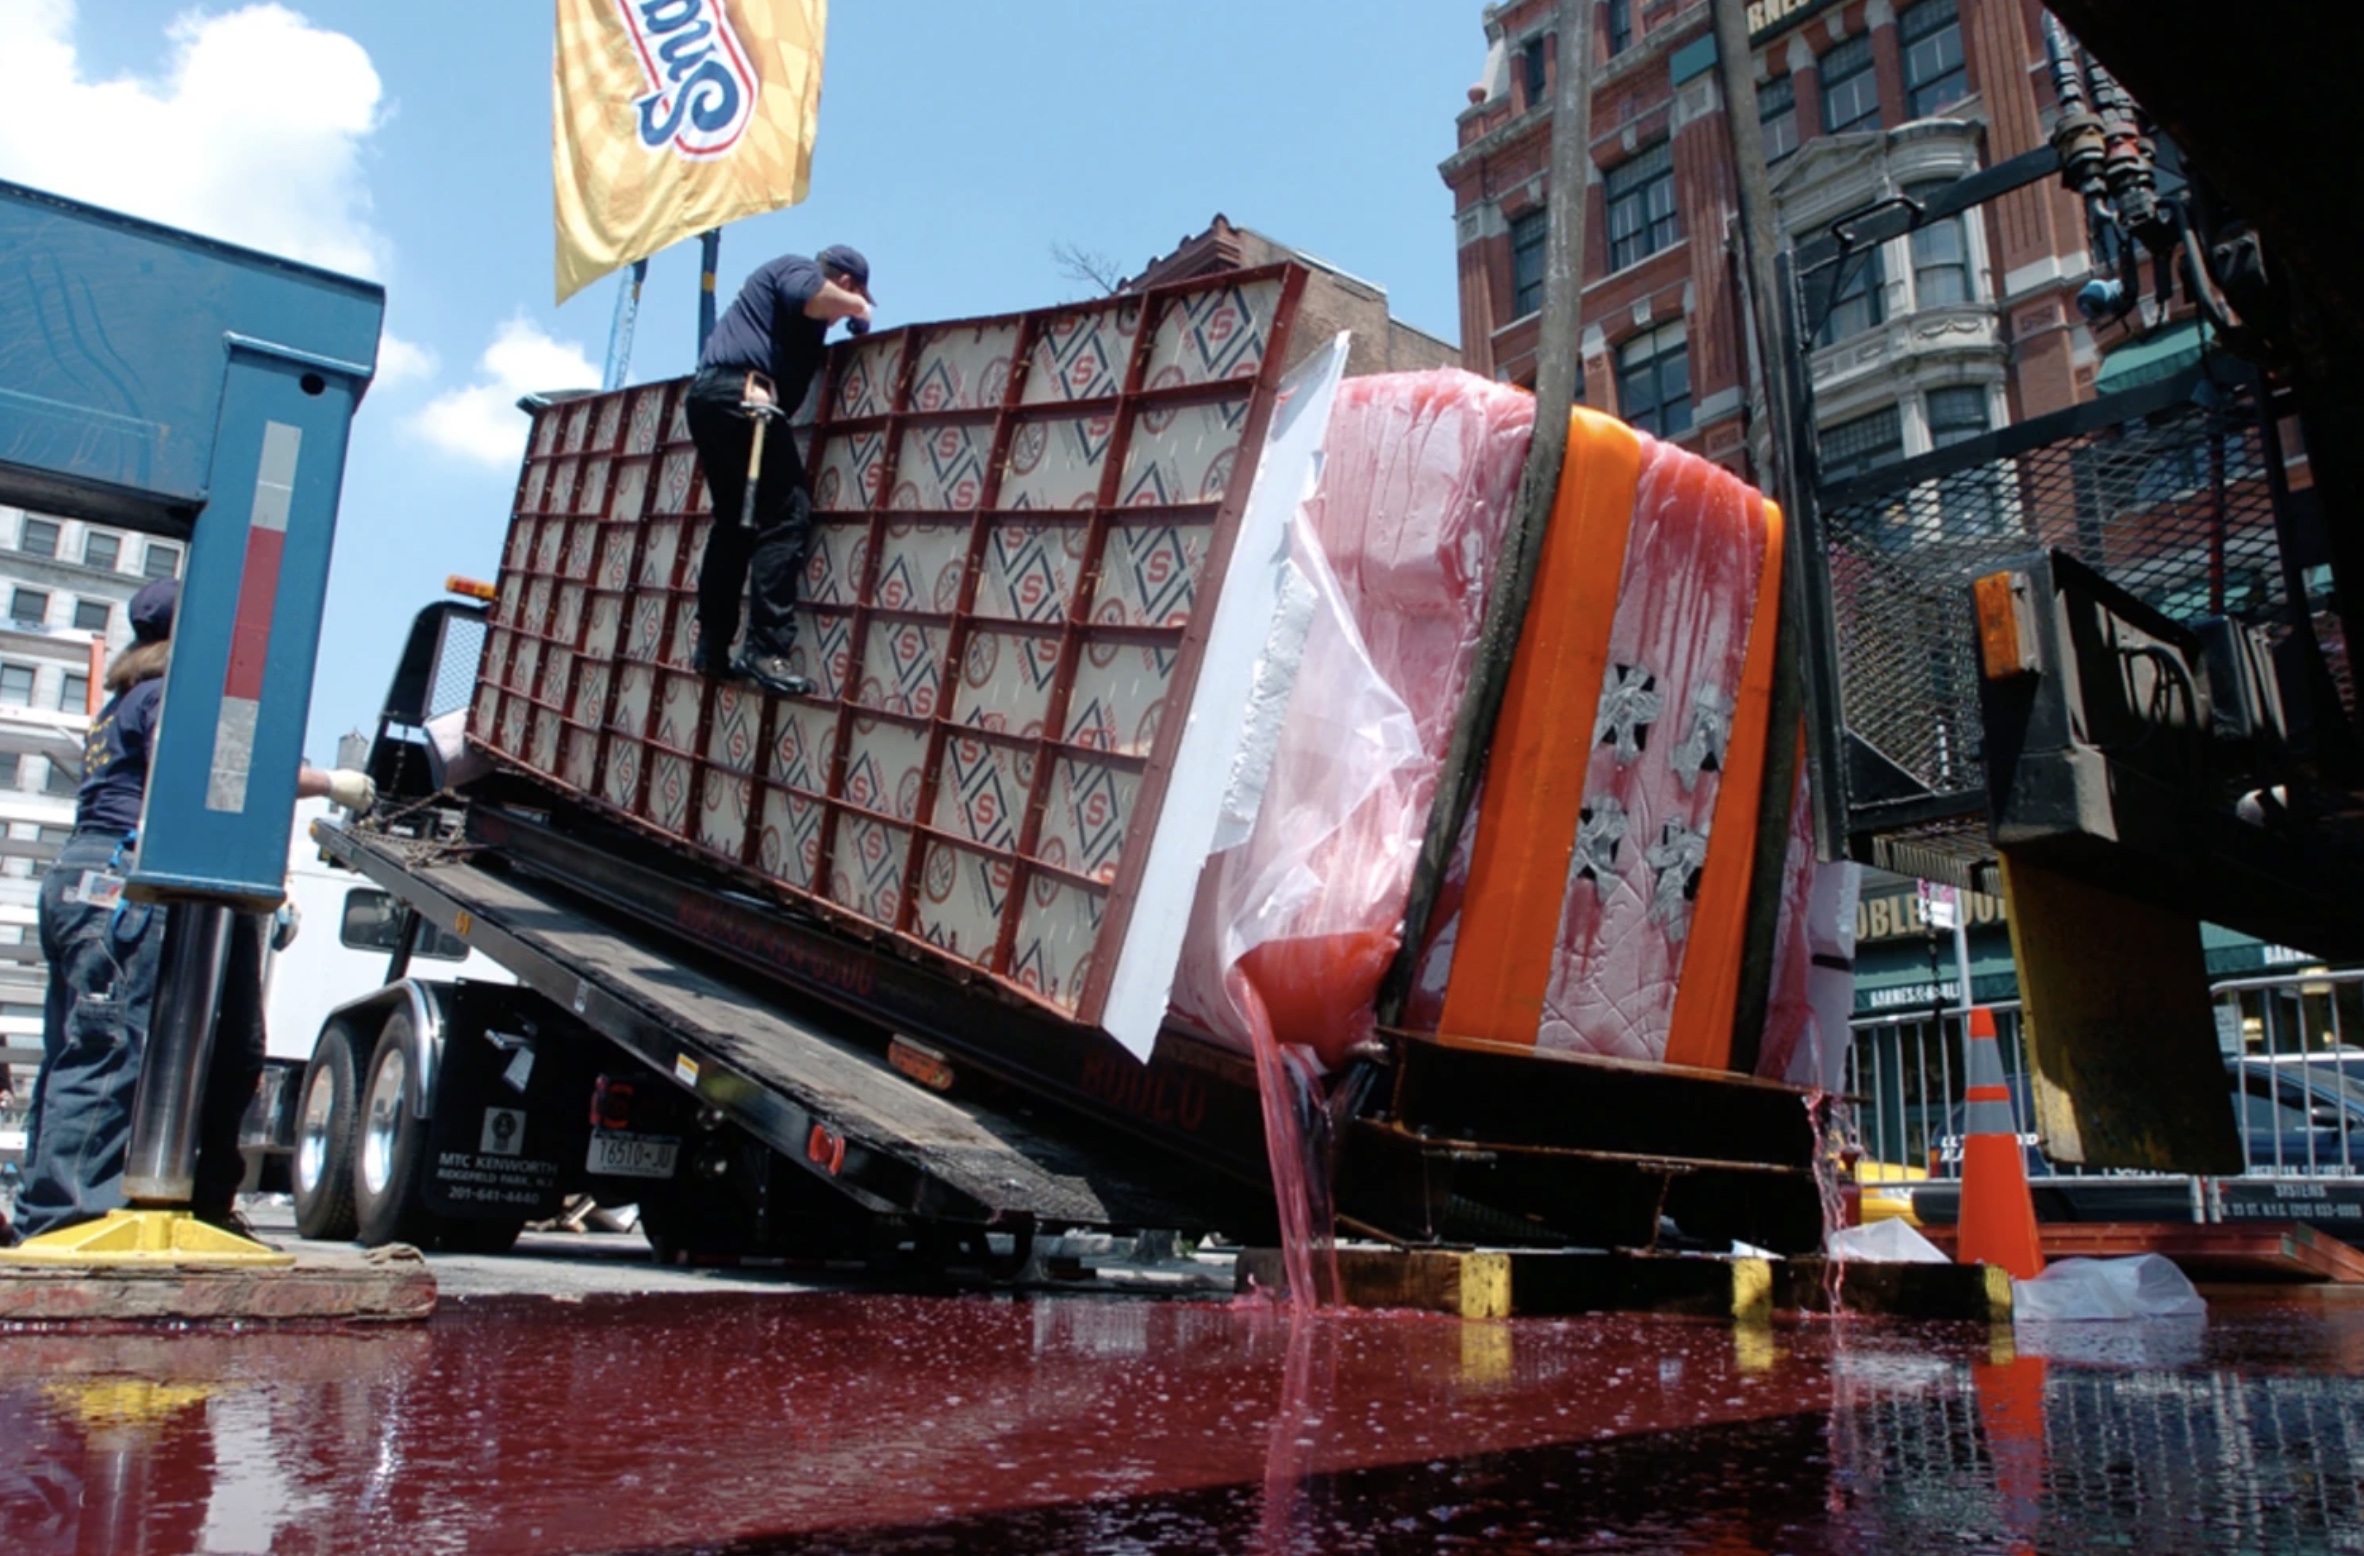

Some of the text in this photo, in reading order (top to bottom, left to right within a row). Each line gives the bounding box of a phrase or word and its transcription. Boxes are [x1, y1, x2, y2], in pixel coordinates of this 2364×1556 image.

[1208, 308, 1235, 341] S
[1072, 356, 1094, 384] S
[922, 384, 941, 410] S
[939, 431, 958, 457] S
[866, 463, 881, 487] S
[955, 481, 975, 507] S
[810, 557, 825, 581] S
[1147, 550, 1172, 582] S
[885, 580, 903, 607] S
[1021, 574, 1044, 604] S
[900, 632, 918, 659] S
[832, 653, 848, 677] S
[915, 686, 933, 714] S
[731, 734, 744, 757] S
[781, 736, 795, 761] S
[960, 737, 978, 764] S
[853, 775, 868, 803] S
[975, 793, 996, 825] S
[1085, 792, 1108, 827] S
[804, 838, 817, 864] S
[866, 831, 881, 860] S
[880, 889, 896, 919] S
[1856, 892, 1925, 941] OBLE
[438, 1151, 558, 1175] MTC KENWORTH
